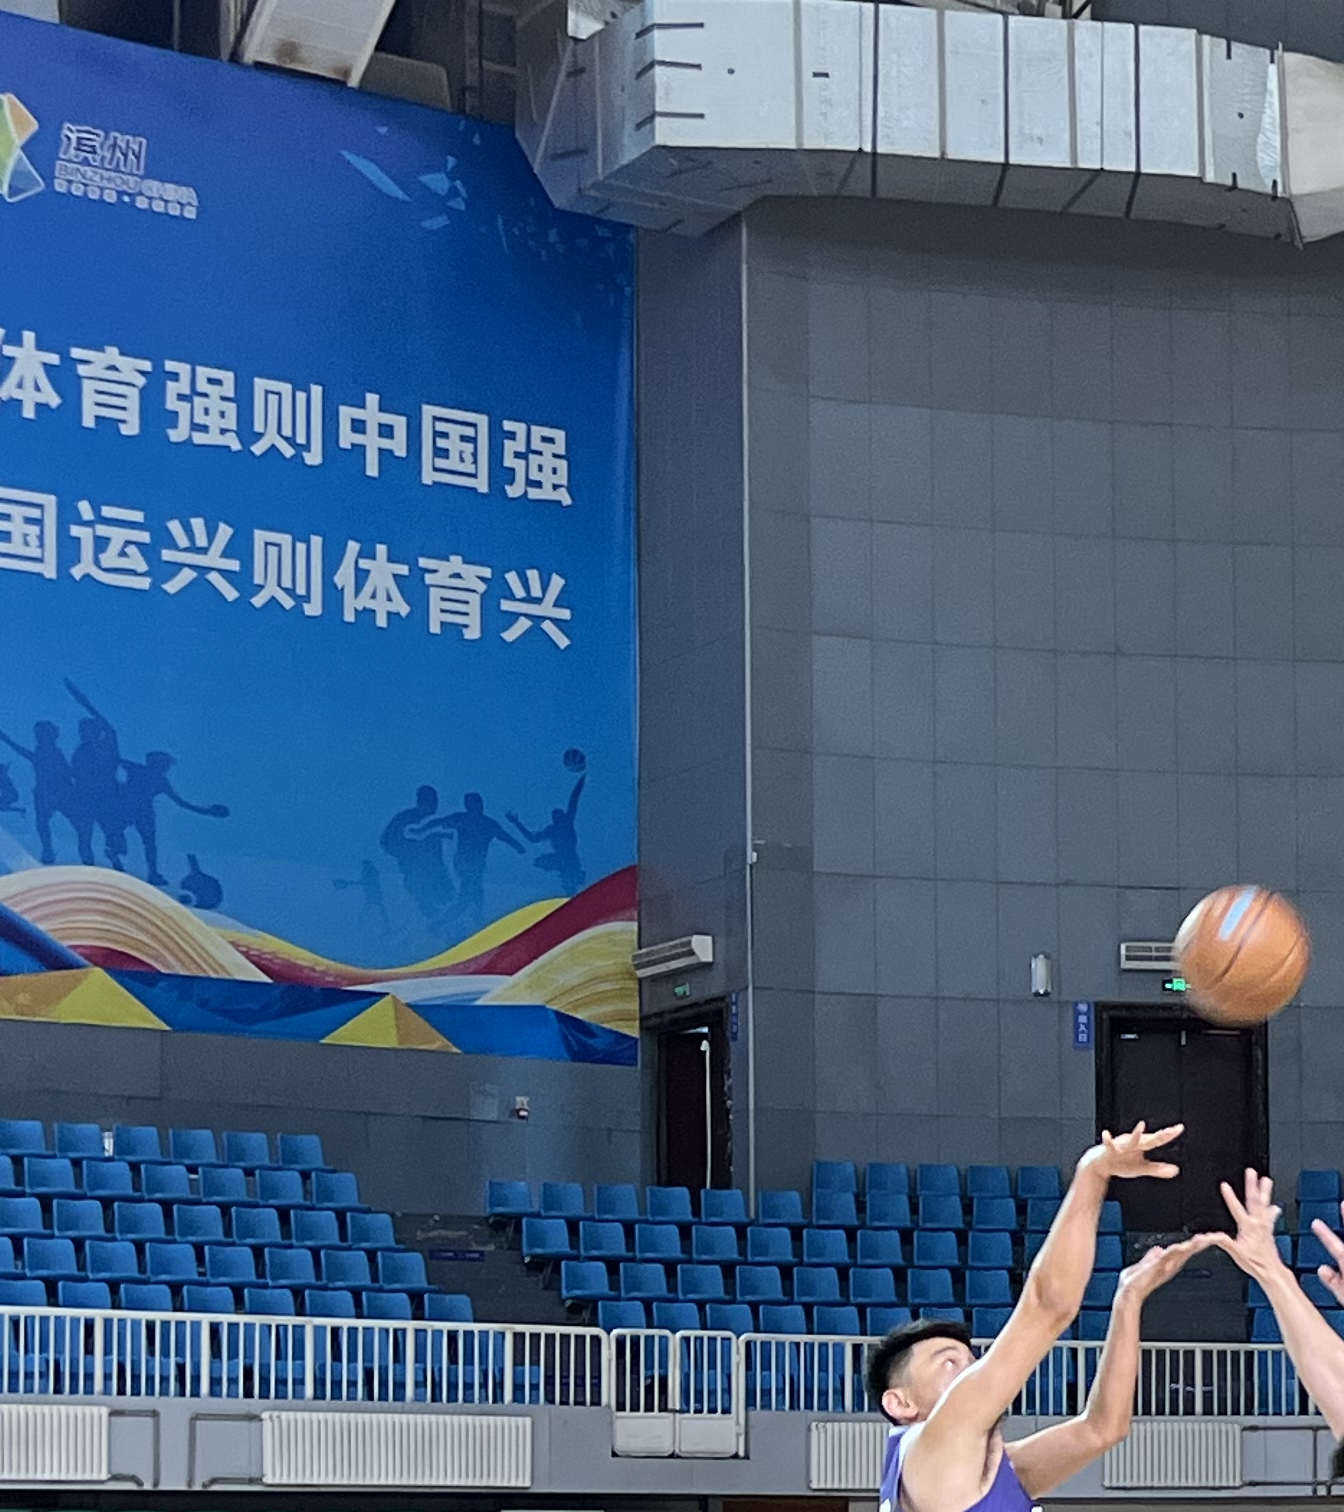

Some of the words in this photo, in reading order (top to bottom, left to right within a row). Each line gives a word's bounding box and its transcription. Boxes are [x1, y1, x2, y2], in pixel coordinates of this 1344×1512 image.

[57, 162, 140, 192] BINZHOU
[60, 123, 146, 174] 滨州
[0, 329, 572, 506] 体育强则中国强
[0, 486, 571, 649] 国运兴则体育兴
